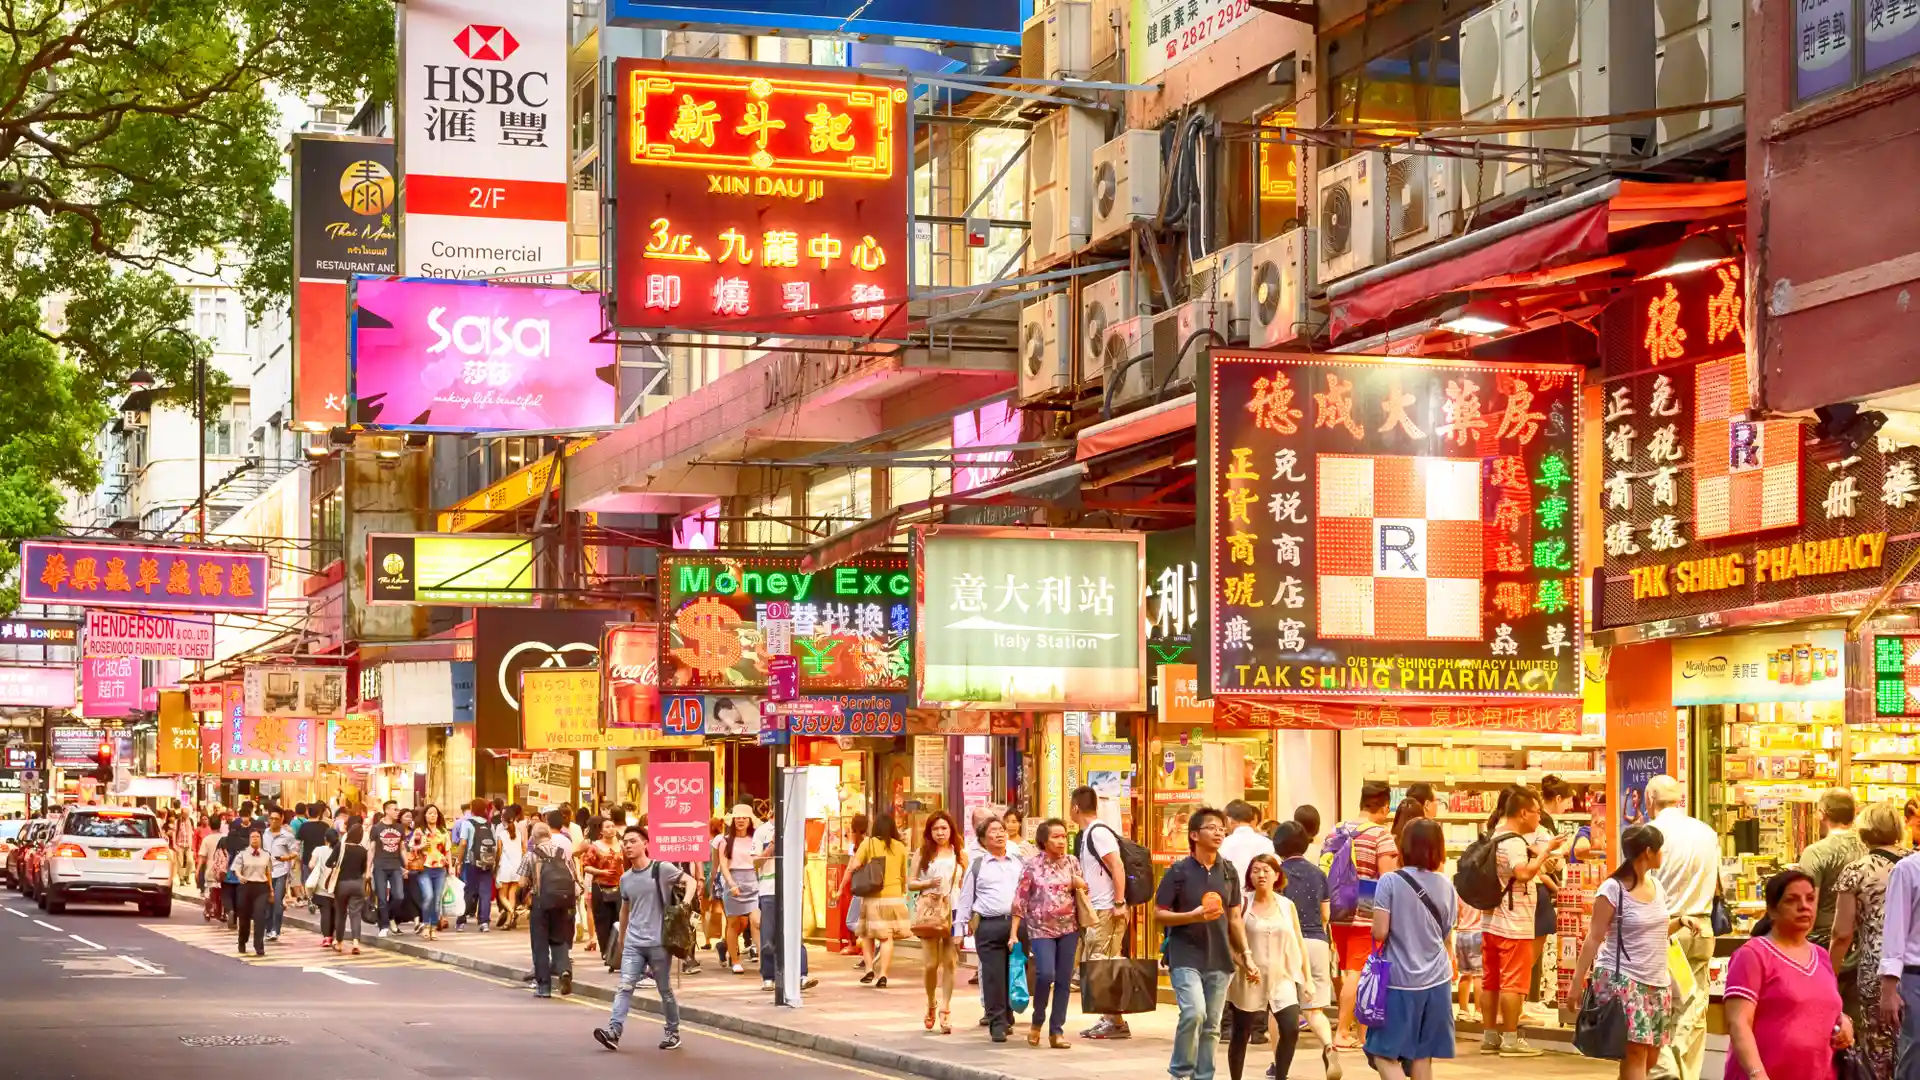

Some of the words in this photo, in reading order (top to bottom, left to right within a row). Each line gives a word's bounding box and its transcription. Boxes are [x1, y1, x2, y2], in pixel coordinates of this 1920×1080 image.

[1182, 16, 1214, 51] 2827
[423, 64, 549, 108] HSBC
[670, 94, 855, 153] 新斗記
[469, 187, 506, 210] 2/F
[707, 174, 749, 195] XIN
[755, 177, 803, 198] DAU
[805, 179, 824, 203] JI
[432, 241, 541, 262] Commercial
[717, 227, 886, 270] 九龍中心
[316, 260, 375, 272] RESTAURANT
[1247, 370, 1547, 446] 德成大藥房
[1629, 564, 1669, 600] TAK
[1677, 553, 1745, 594] SHING
[1756, 532, 1887, 582] PHARMACY
[680, 567, 812, 601] Money
[950, 572, 1116, 617] 意大利站
[30, 629, 74, 639] BONJOUR
[91, 614, 174, 640] HENDERSON
[90, 640, 133, 654] ROSEWOOD
[135, 642, 176, 655] FURNITURE
[185, 643, 209, 657] CHEST
[994, 632, 1030, 652] Italy
[1036, 633, 1098, 650] Station
[1371, 657, 1394, 669] TAK
[1510, 660, 1559, 671] LIMITED
[1235, 664, 1291, 688] TAK
[1300, 665, 1391, 690] SHING
[1401, 668, 1559, 692] PHARMACY
[840, 695, 892, 710] Service
[665, 698, 703, 733] 4D
[792, 711, 845, 733] 3599
[850, 711, 903, 734] 8899
[55, 729, 93, 737] BESPOKE
[95, 730, 132, 738] TALORS
[546, 732, 600, 744] Welcome
[1627, 755, 1665, 771] ANNECY
